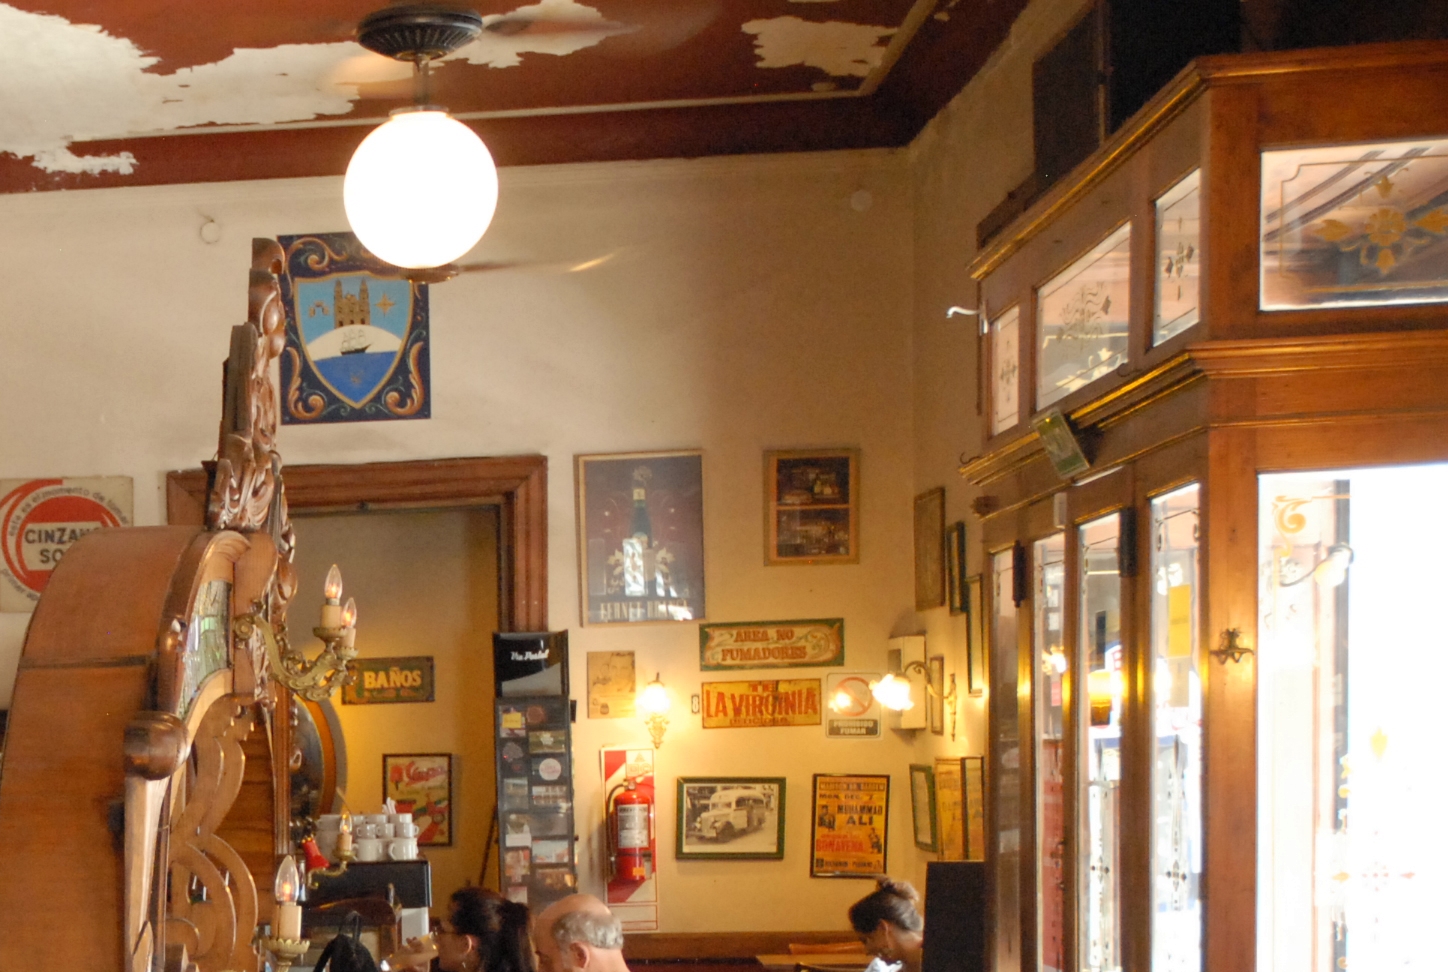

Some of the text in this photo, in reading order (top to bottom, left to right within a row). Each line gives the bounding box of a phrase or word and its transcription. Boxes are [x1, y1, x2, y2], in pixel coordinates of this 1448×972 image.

[24, 527, 101, 544] CINZA
[40, 548, 64, 564] SO
[600, 601, 643, 620] FERNET
[734, 628, 795, 643] AREA NO
[721, 645, 808, 662] FUMADORES
[363, 666, 422, 689] BAÑOS
[705, 688, 818, 718] LA VIRGINIA
[840, 728, 867, 736] FUMAR
[837, 804, 883, 815] MUHAMMAD
[846, 815, 874, 826] ALI
[815, 839, 865, 852] BONAVENA
